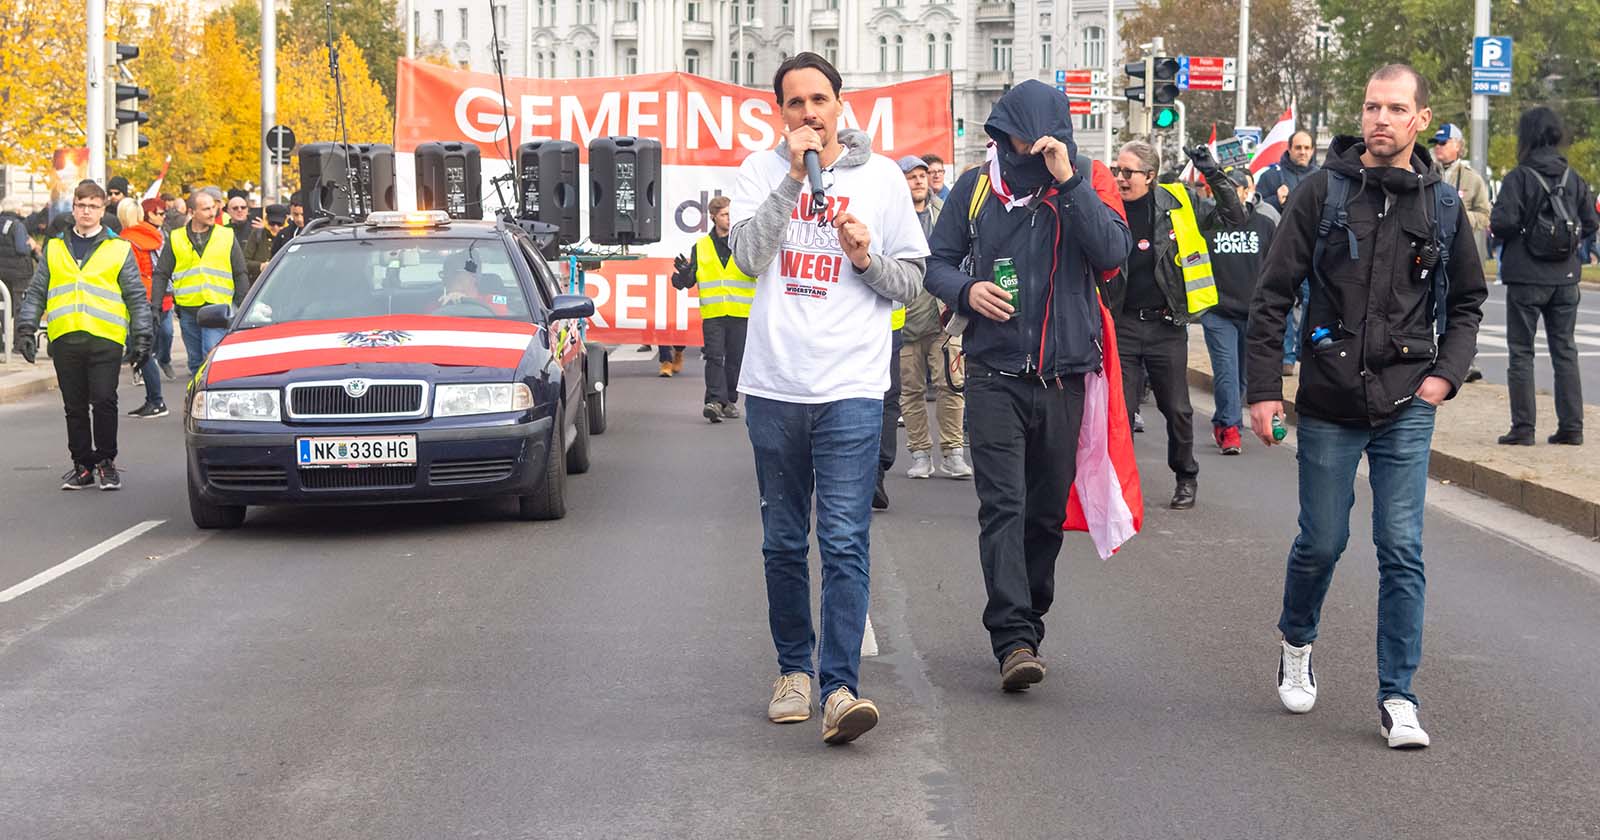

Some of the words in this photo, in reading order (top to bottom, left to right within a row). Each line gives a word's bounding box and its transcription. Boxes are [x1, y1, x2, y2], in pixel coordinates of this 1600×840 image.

[1474, 82, 1489, 91] 200
[454, 87, 895, 151] GEMEINSM
[1213, 241, 1259, 254] JONES
[780, 250, 842, 283] WEG!
[786, 286, 827, 296] WIDERSTAND
[314, 442, 336, 460] NK
[350, 441, 383, 459] 336
[387, 441, 409, 458] HG
